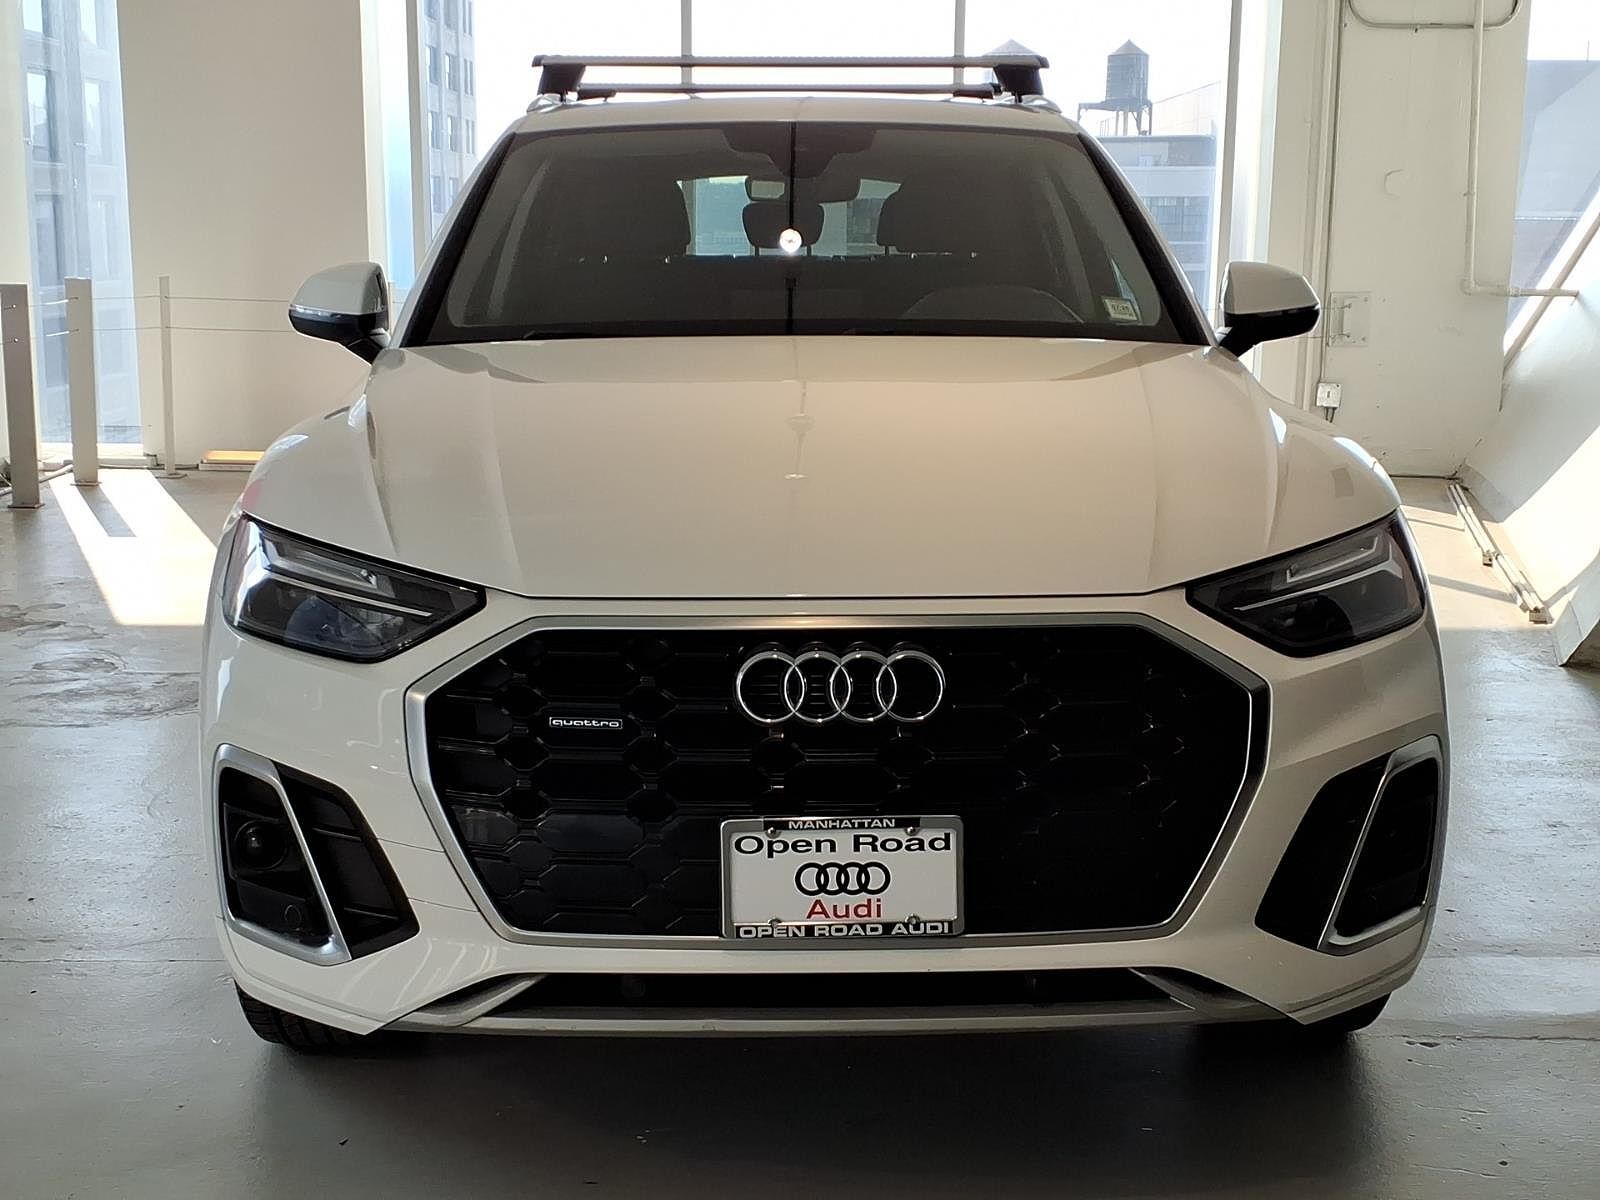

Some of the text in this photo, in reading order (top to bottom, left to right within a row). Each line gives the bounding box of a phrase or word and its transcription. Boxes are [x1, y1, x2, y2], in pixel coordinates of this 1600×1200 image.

[552, 719, 619, 727] quattro
[788, 819, 896, 829] MANHATTAN
[734, 832, 952, 858] Open Road
[806, 898, 882, 919] Audi
[739, 922, 949, 938] OPEN ROAD AUDI
